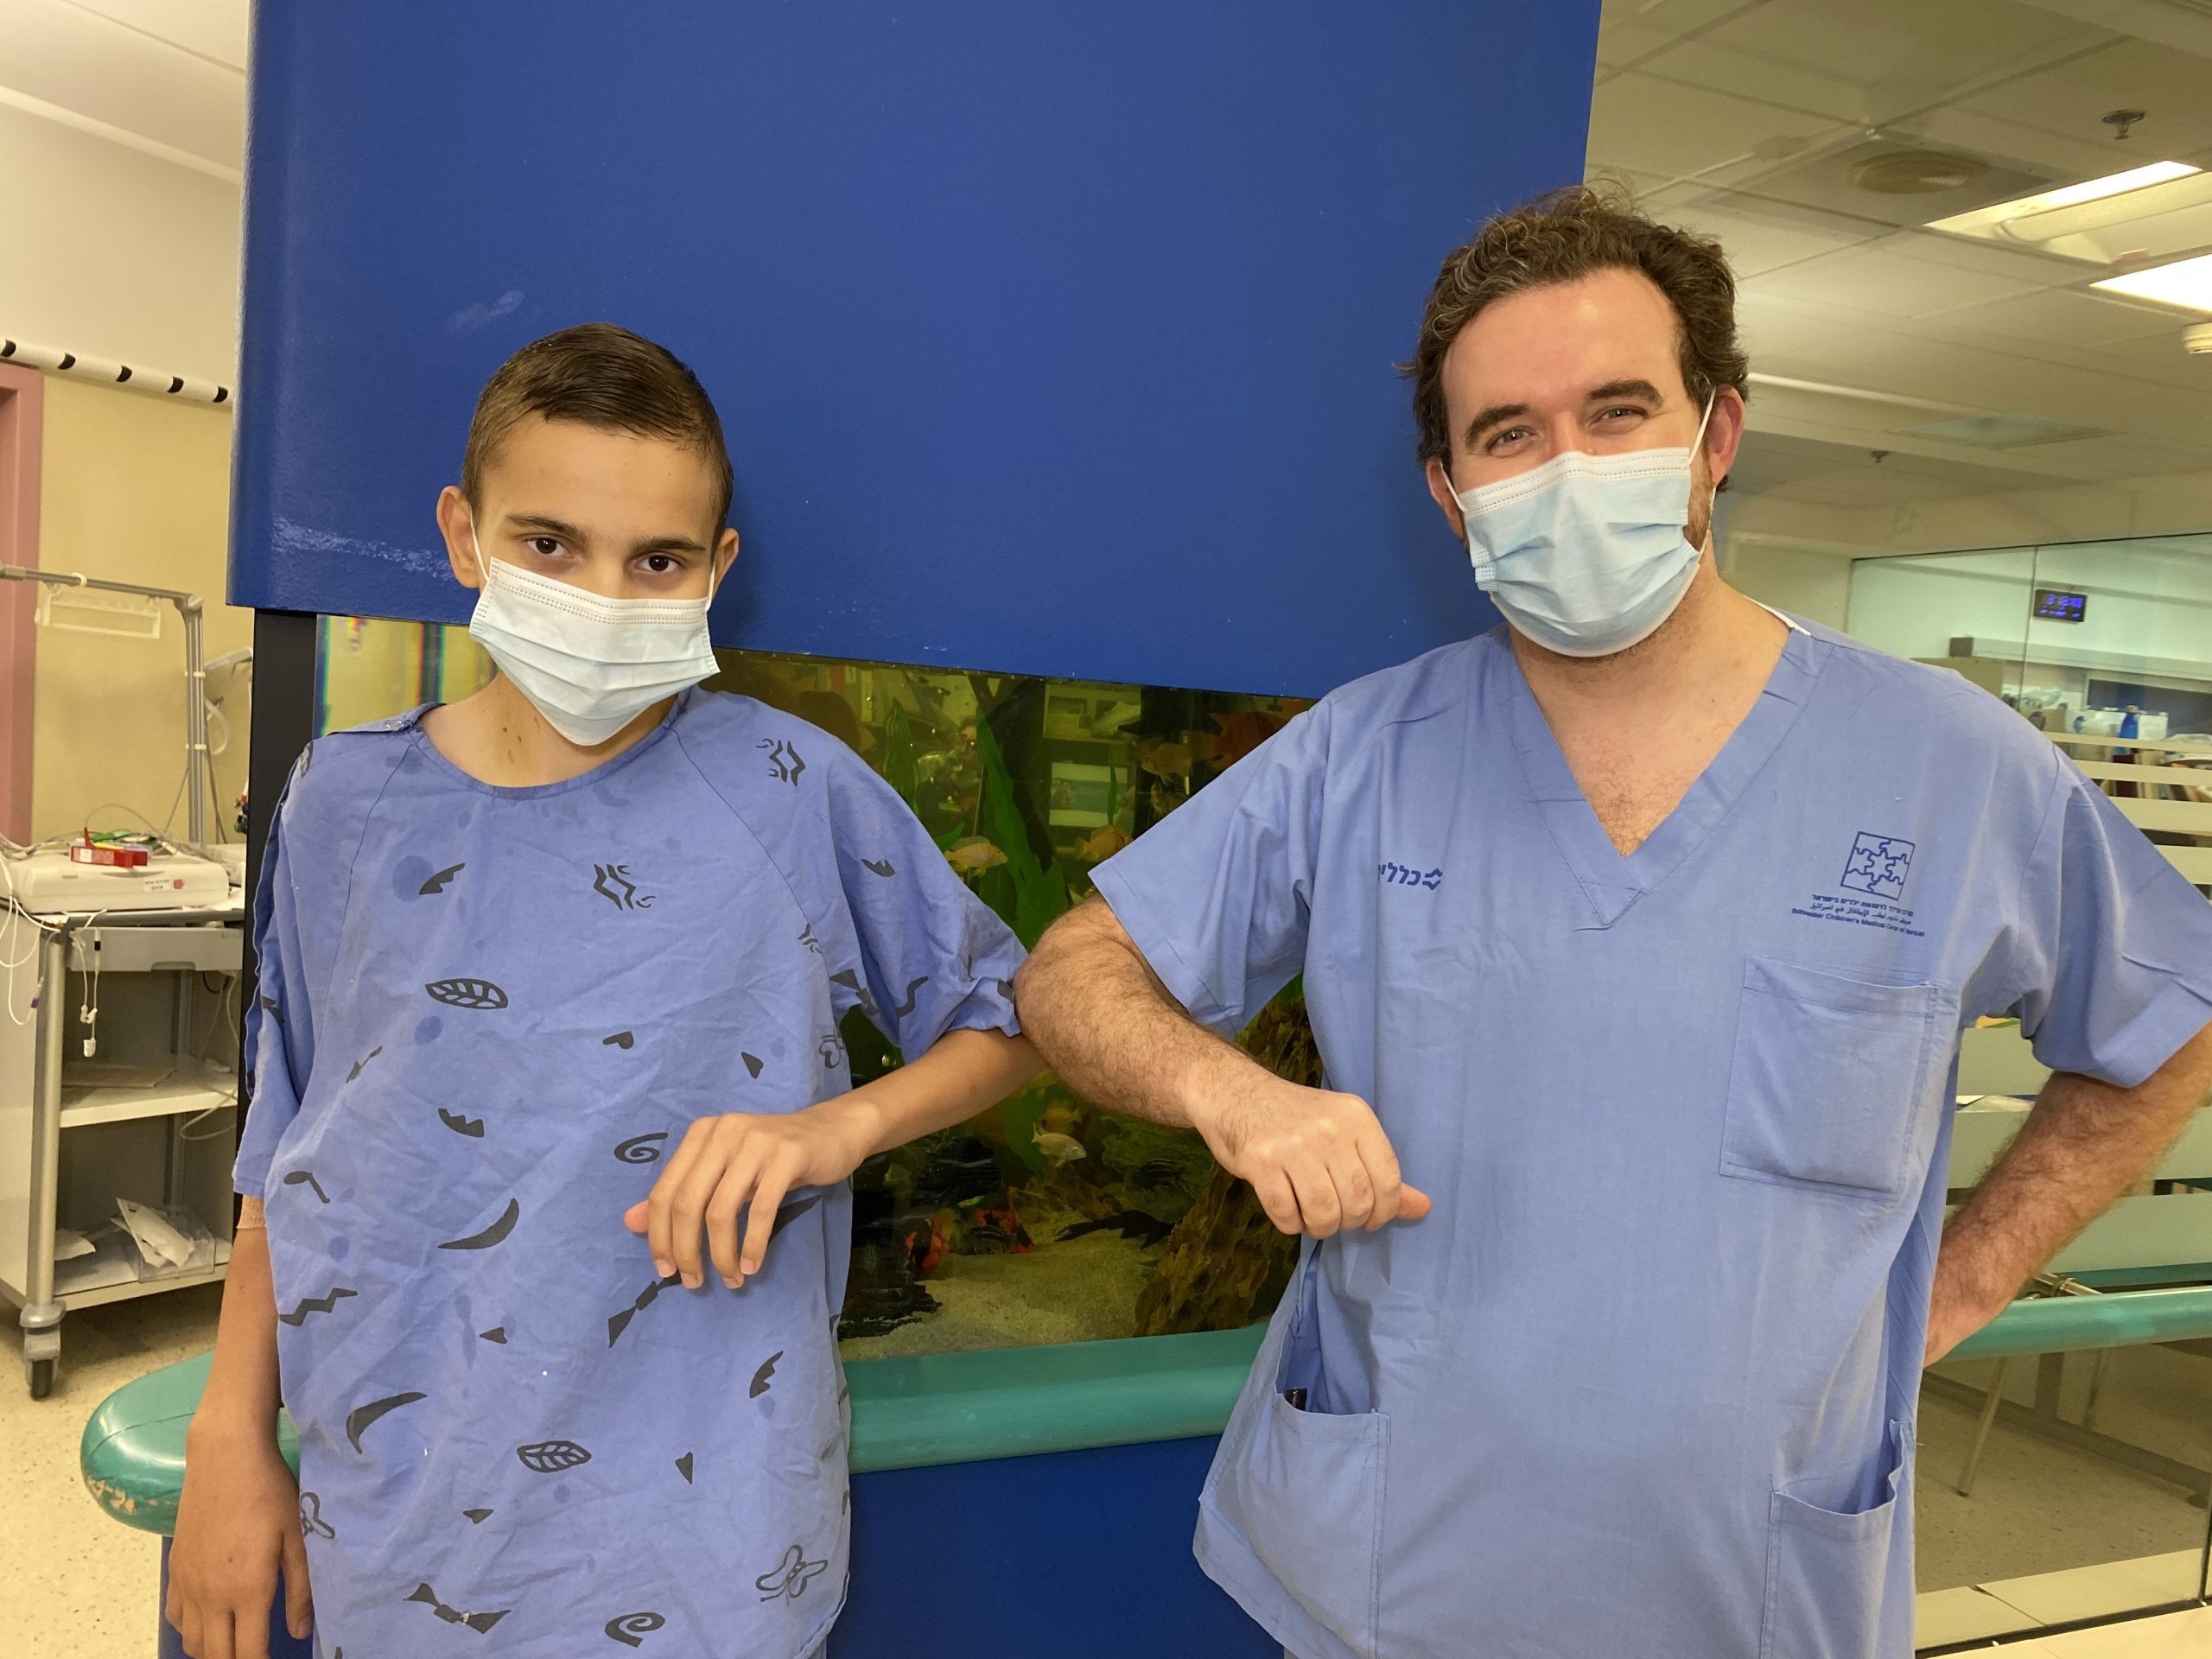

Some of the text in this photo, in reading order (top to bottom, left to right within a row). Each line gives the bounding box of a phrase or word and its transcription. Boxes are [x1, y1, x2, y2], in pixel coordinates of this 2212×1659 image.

[1377, 861, 1421, 887] כללי
[1791, 908, 1823, 918] Schneider
[1825, 912, 1860, 924] Children's
[1861, 918, 1886, 929] Medical
